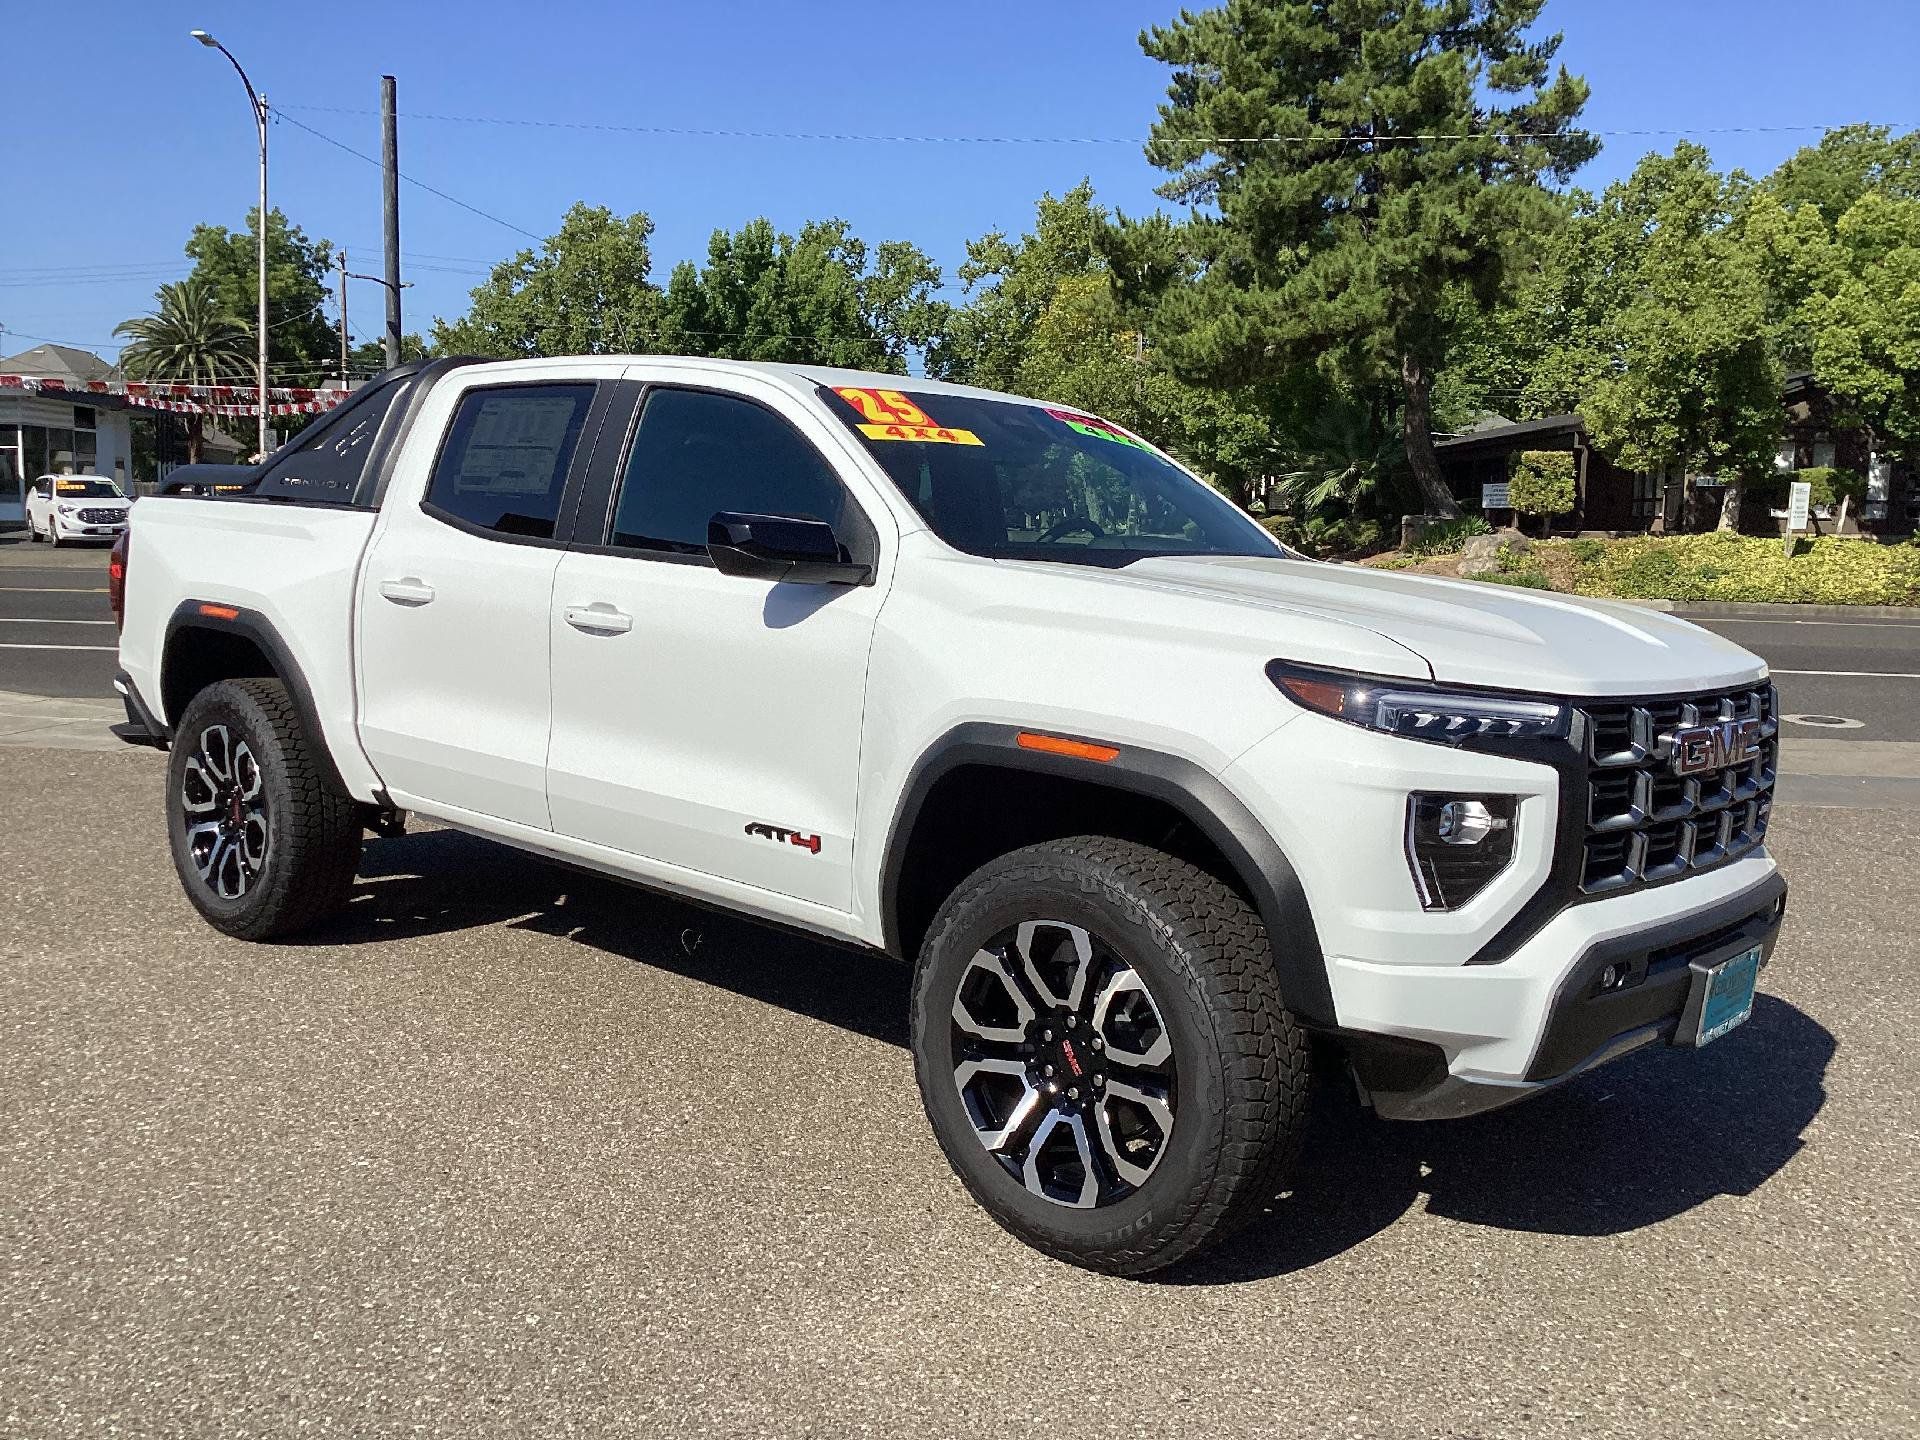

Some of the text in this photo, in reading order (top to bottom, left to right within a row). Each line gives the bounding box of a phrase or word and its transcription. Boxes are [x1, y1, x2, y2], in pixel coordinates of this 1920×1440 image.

[839, 387, 928, 425] 25
[1673, 719, 1761, 776] GMC
[744, 821, 822, 855] AT4
